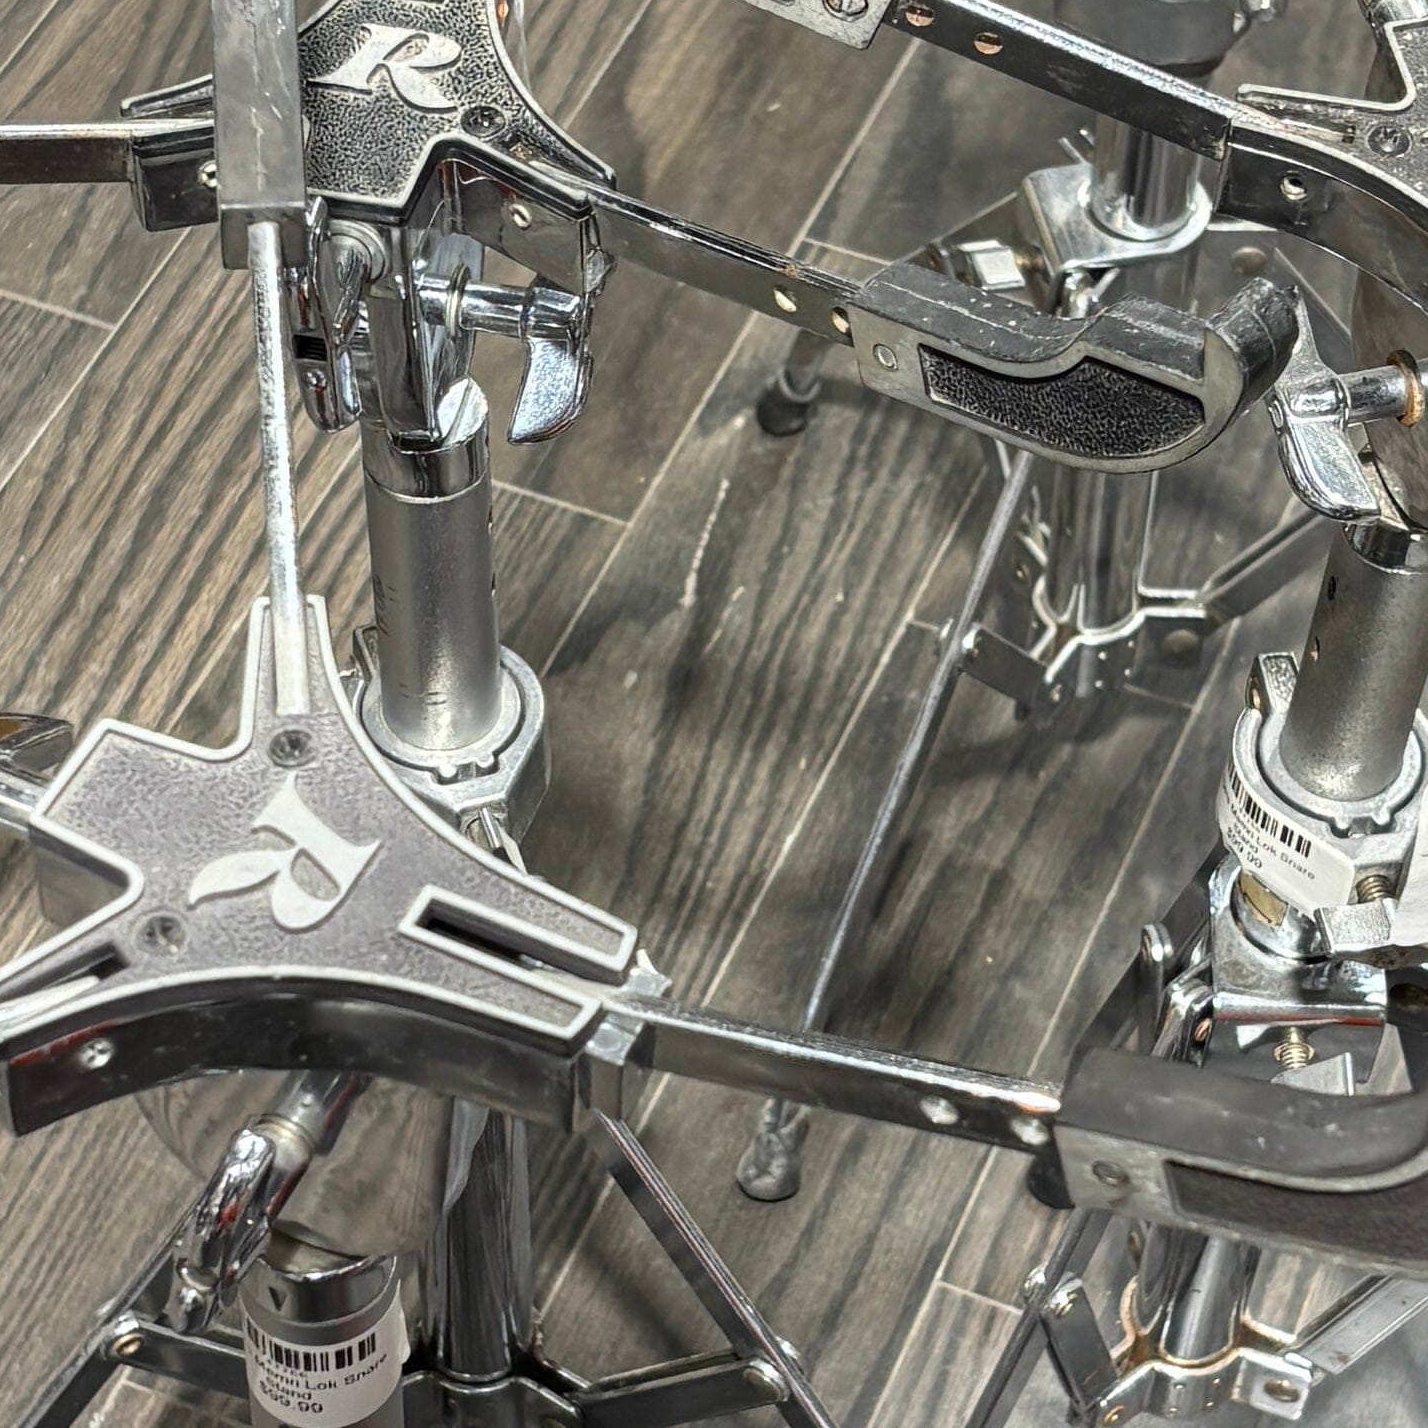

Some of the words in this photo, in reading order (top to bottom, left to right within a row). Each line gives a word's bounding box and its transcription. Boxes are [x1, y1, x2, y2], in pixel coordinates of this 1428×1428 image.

[1280, 852, 1315, 880] Snare
[305, 1380, 337, 1390] Lok
[344, 1352, 388, 1385] Snare
[266, 1376, 312, 1400] Stand
